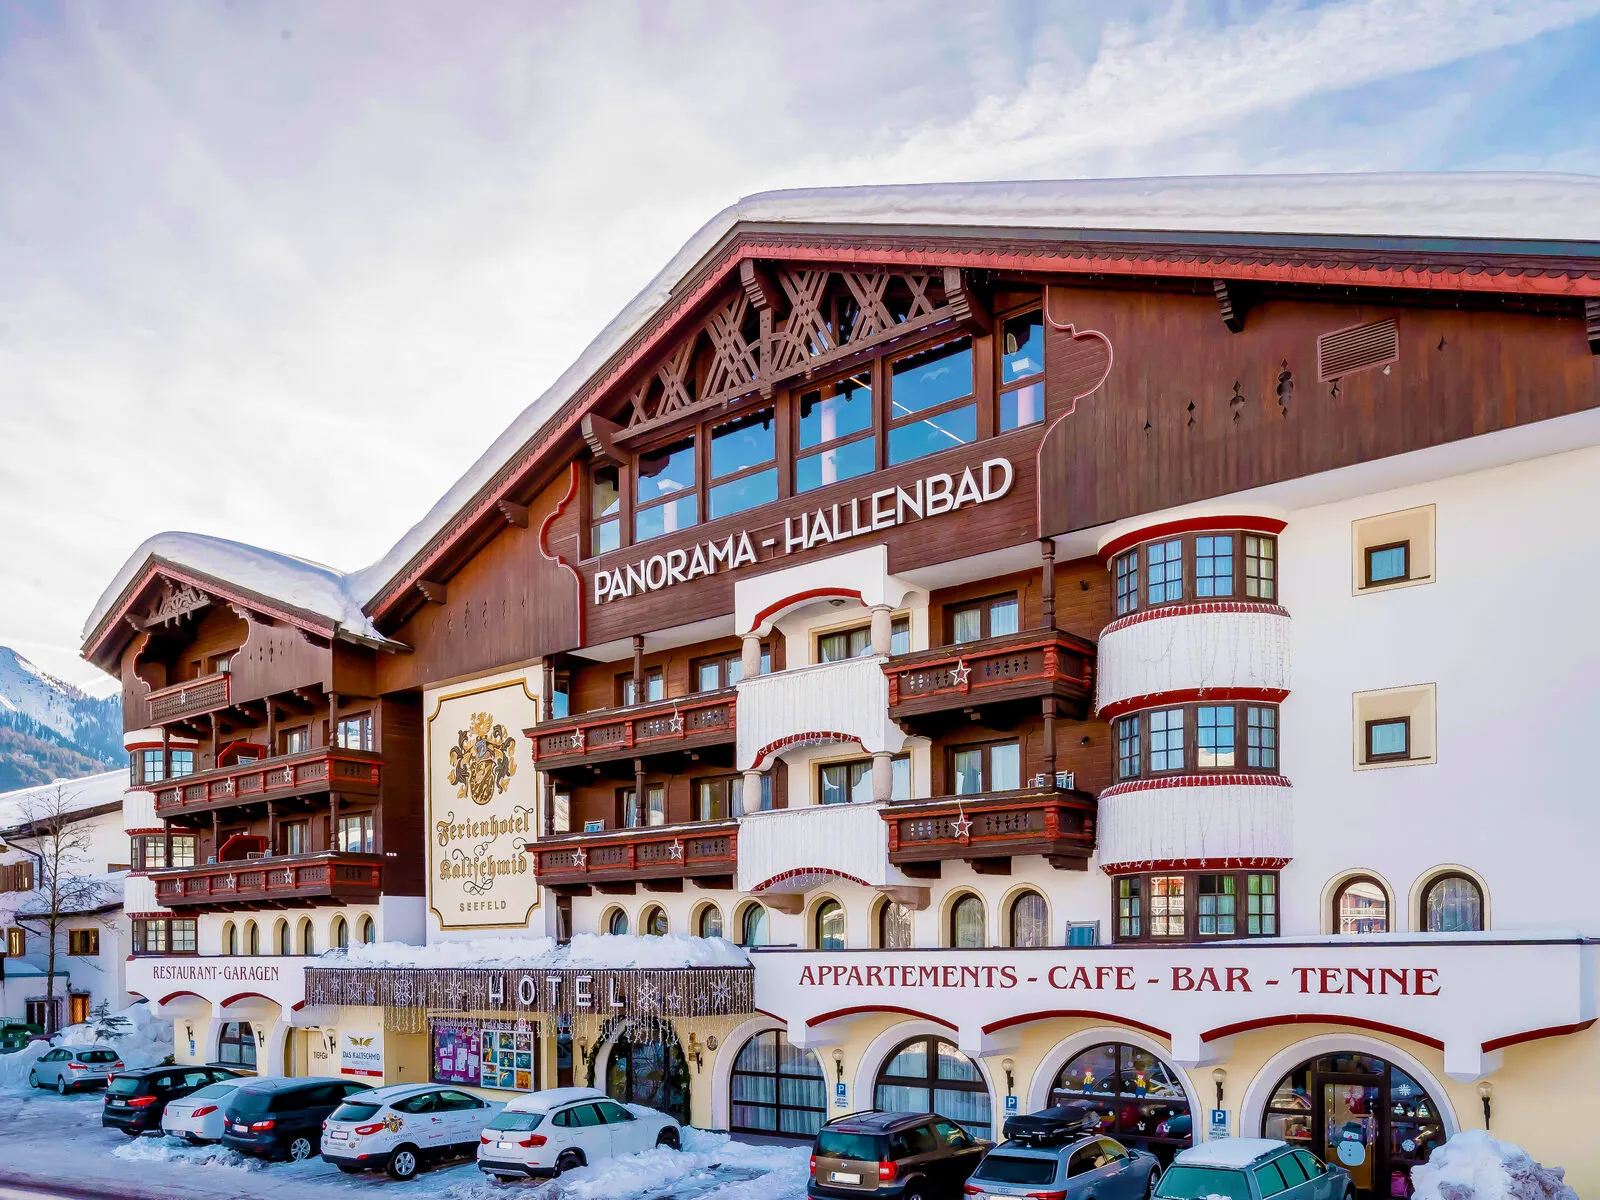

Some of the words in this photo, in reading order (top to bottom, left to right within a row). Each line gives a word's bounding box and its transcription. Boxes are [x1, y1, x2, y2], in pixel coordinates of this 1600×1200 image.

[594, 530, 757, 605] PANORAMA
[762, 538, 775, 547] -
[784, 457, 1014, 554] HALLENBAD
[436, 806, 534, 848] Ferienhotel
[459, 900, 507, 912] SEEFELD
[799, 966, 1018, 988] APPARTEMENTS
[1047, 966, 1136, 990] CAFE
[1171, 966, 1252, 992] BAR
[1292, 967, 1442, 996] TENNE
[488, 974, 624, 1007] HOTEL
[342, 1051, 352, 1059] DAS
[838, 1084, 845, 1094] P
[1008, 1097, 1016, 1108] P
[1215, 1111, 1224, 1123] P
